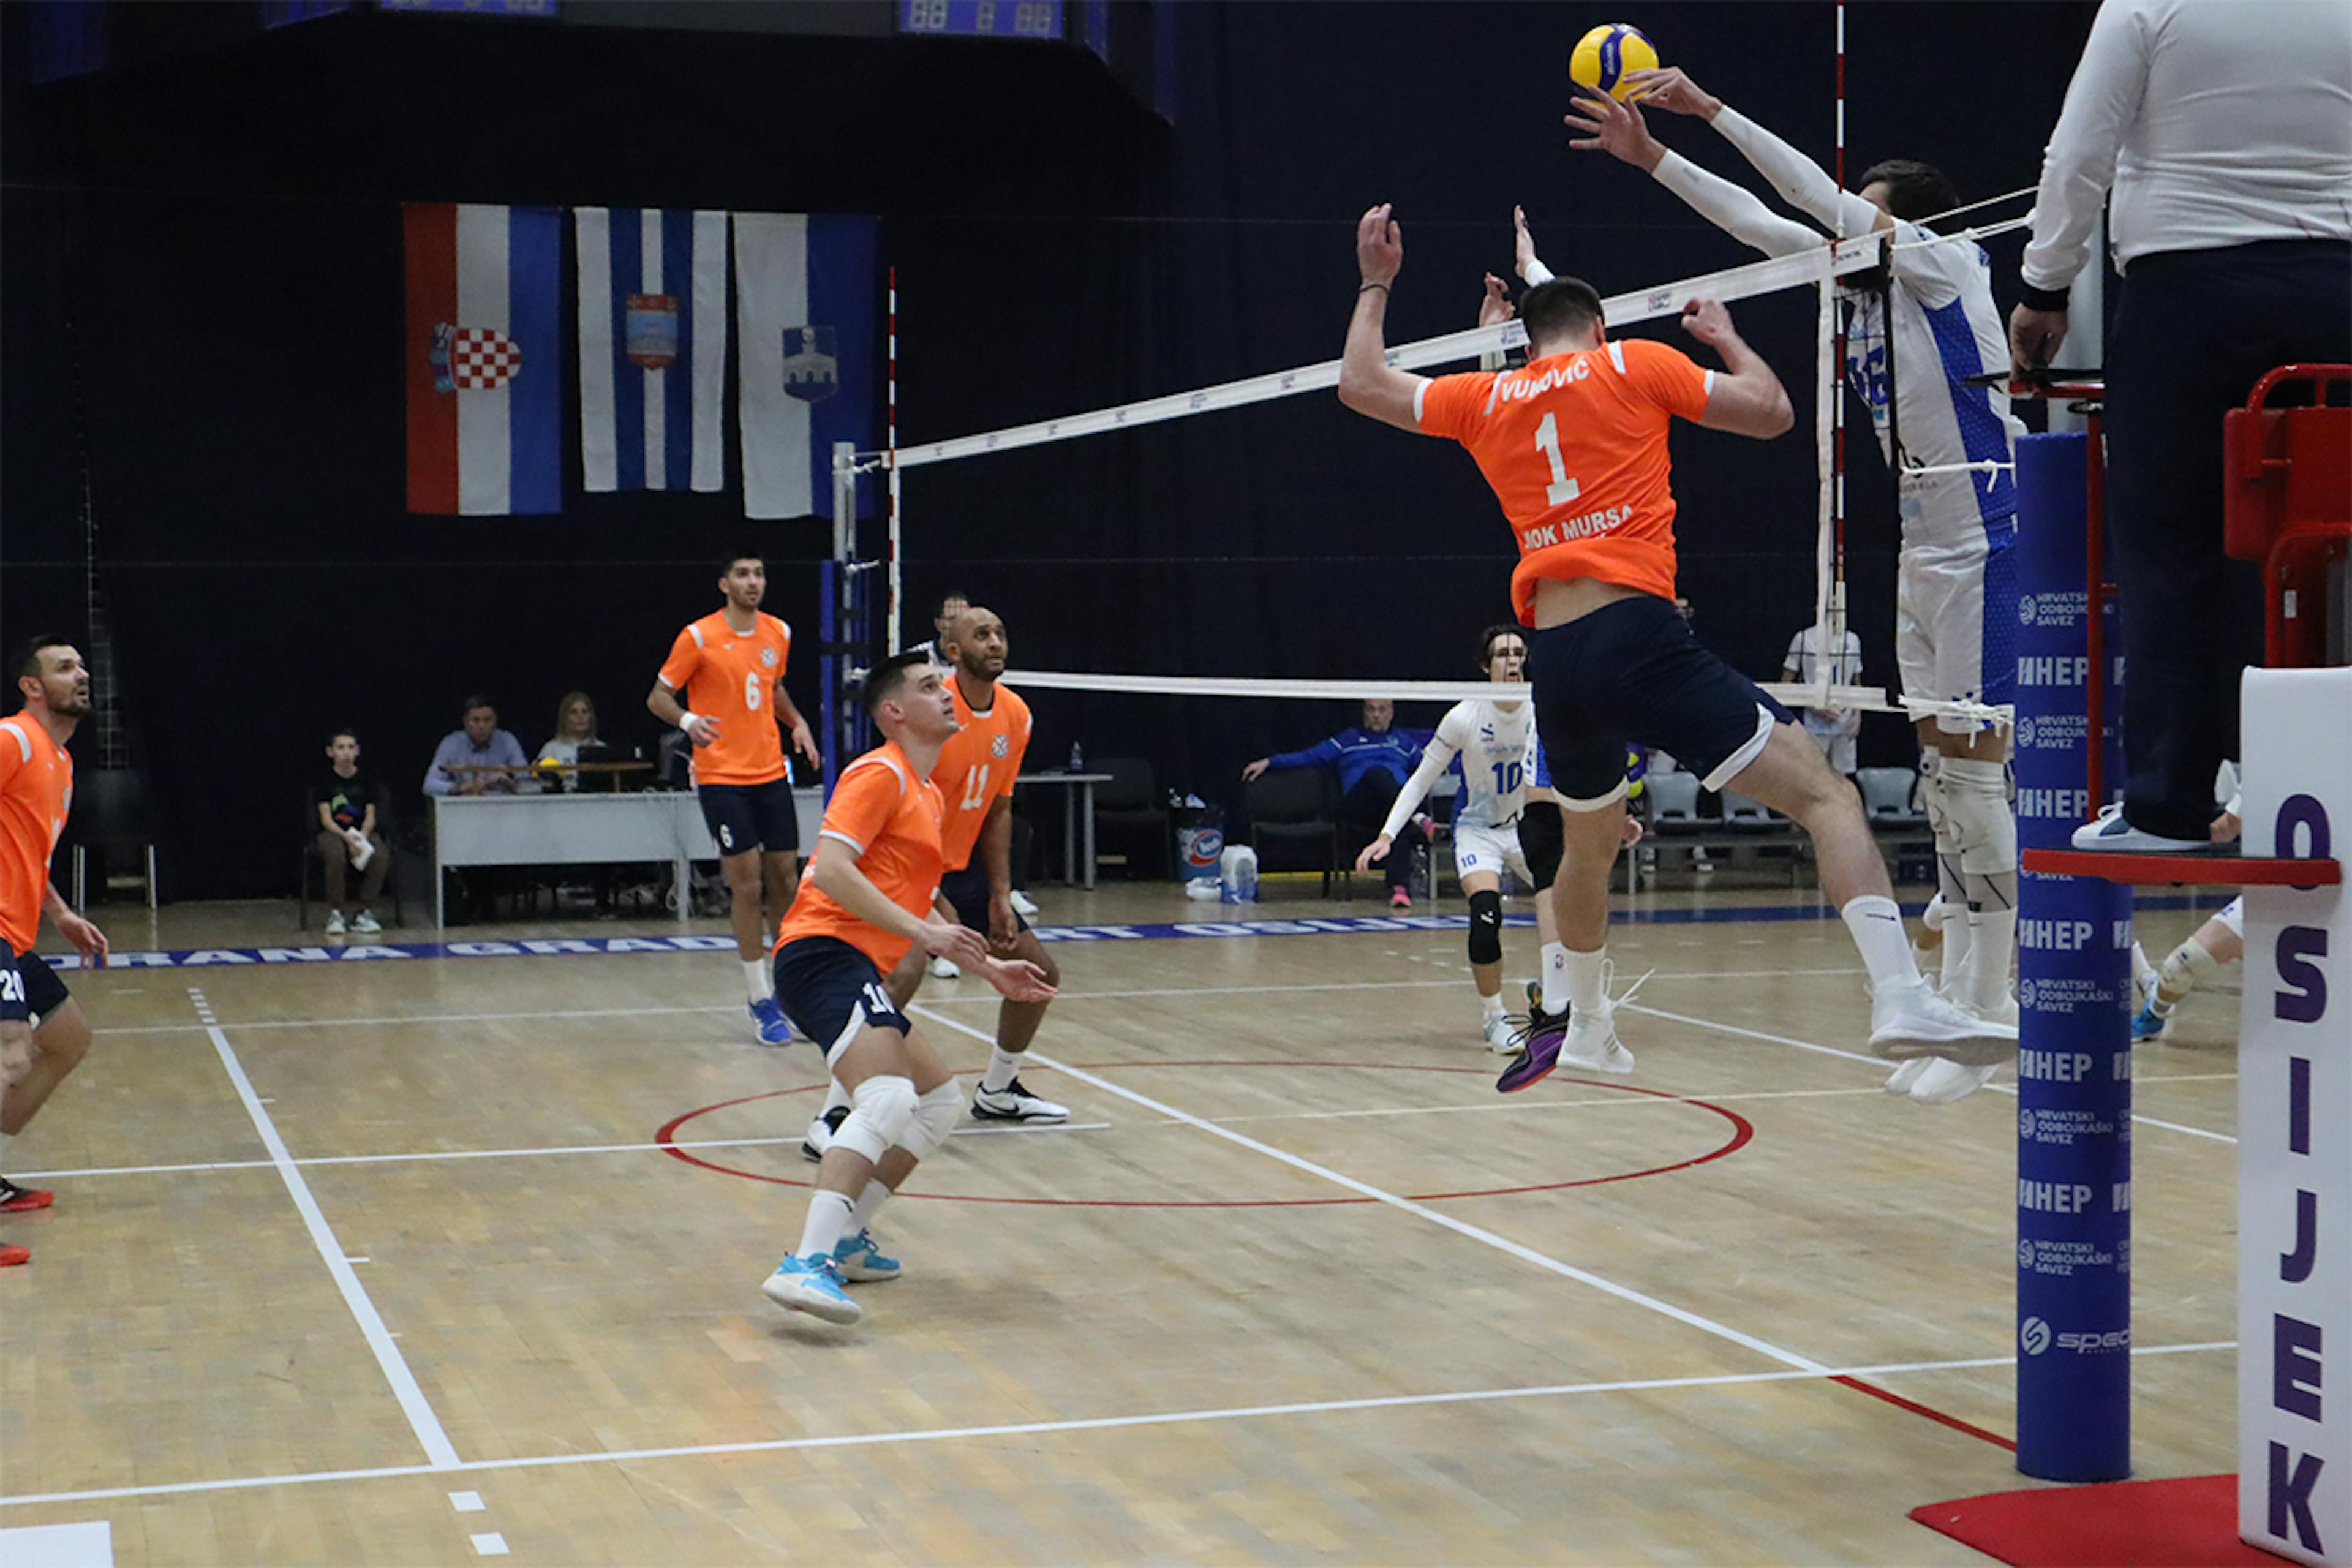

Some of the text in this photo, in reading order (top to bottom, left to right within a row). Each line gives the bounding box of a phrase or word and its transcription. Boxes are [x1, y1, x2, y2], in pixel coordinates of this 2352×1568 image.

[1534, 412, 1580, 507] 1
[1561, 504, 1633, 541] MURSA
[2036, 592, 2087, 603] HRVATS
[2037, 615, 2075, 626] SAVEZ
[2036, 657, 2089, 685] HEP
[745, 672, 761, 711] 6
[2035, 716, 2087, 726] HRVATS
[2035, 738, 2073, 749] SAVEZ
[1491, 762, 1523, 794] 10
[960, 764, 989, 810] 11
[2035, 789, 2089, 818] HEP
[720, 824, 733, 848] 6
[1461, 854, 1477, 867] 10
[446, 937, 739, 956] GRAD
[1030, 925, 1144, 941] RT
[2037, 922, 2093, 949] HEP
[1, 969, 26, 1002] 20
[2036, 979, 2095, 991] HRVATSKI
[2038, 989, 2113, 1003] ODBOJKAŠKI
[2037, 1000, 2074, 1012] SAVEZ
[2036, 1052, 2093, 1082] HEP
[2036, 1110, 2095, 1122] HRVATSKI
[2038, 1120, 2113, 1134] ODBOJKAŠKI
[2036, 1131, 2073, 1144] SAVEZ
[2035, 1182, 2092, 1213] HEP
[2035, 1239, 2094, 1253] HRVATSKI
[2037, 1251, 2113, 1265] ODBOJKAŠKI
[2035, 1262, 2073, 1276] SAVEZ
